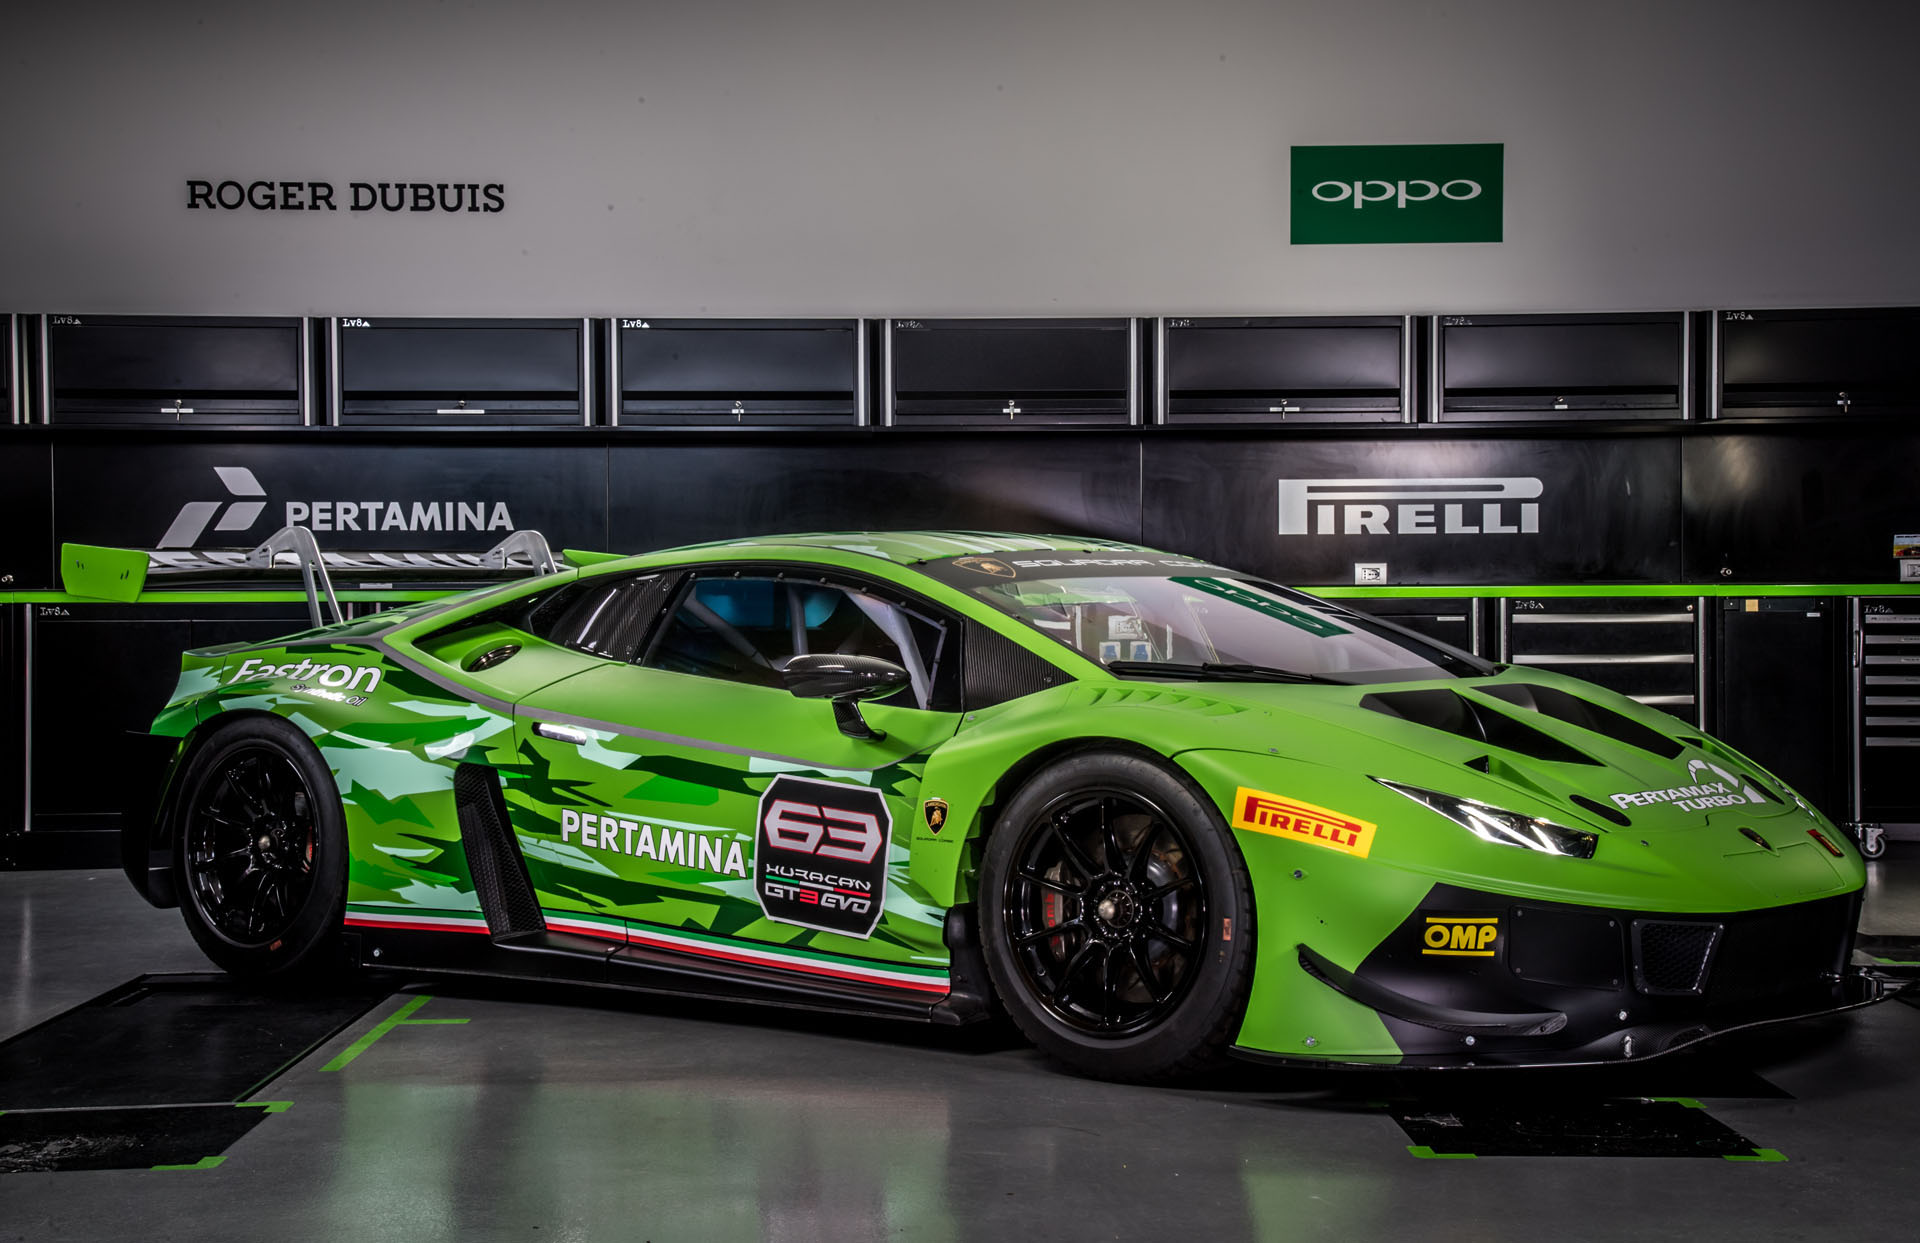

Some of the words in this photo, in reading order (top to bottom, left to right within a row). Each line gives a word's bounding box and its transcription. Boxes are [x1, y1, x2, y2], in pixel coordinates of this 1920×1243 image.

[186, 180, 337, 210] ROGER
[350, 182, 505, 213] DUBUIS
[1311, 179, 1483, 209] oppo
[285, 501, 514, 532] PERTAMINA
[1278, 477, 1544, 535] PIRELLI
[226, 657, 382, 694] Fastron
[1609, 782, 1732, 810] PERTAMAX
[1672, 793, 1747, 812] TURBO
[763, 799, 883, 864] 63
[1243, 796, 1363, 847] PIRELLI
[561, 808, 748, 880] PERTAMINA
[1424, 924, 1498, 950] OMP
